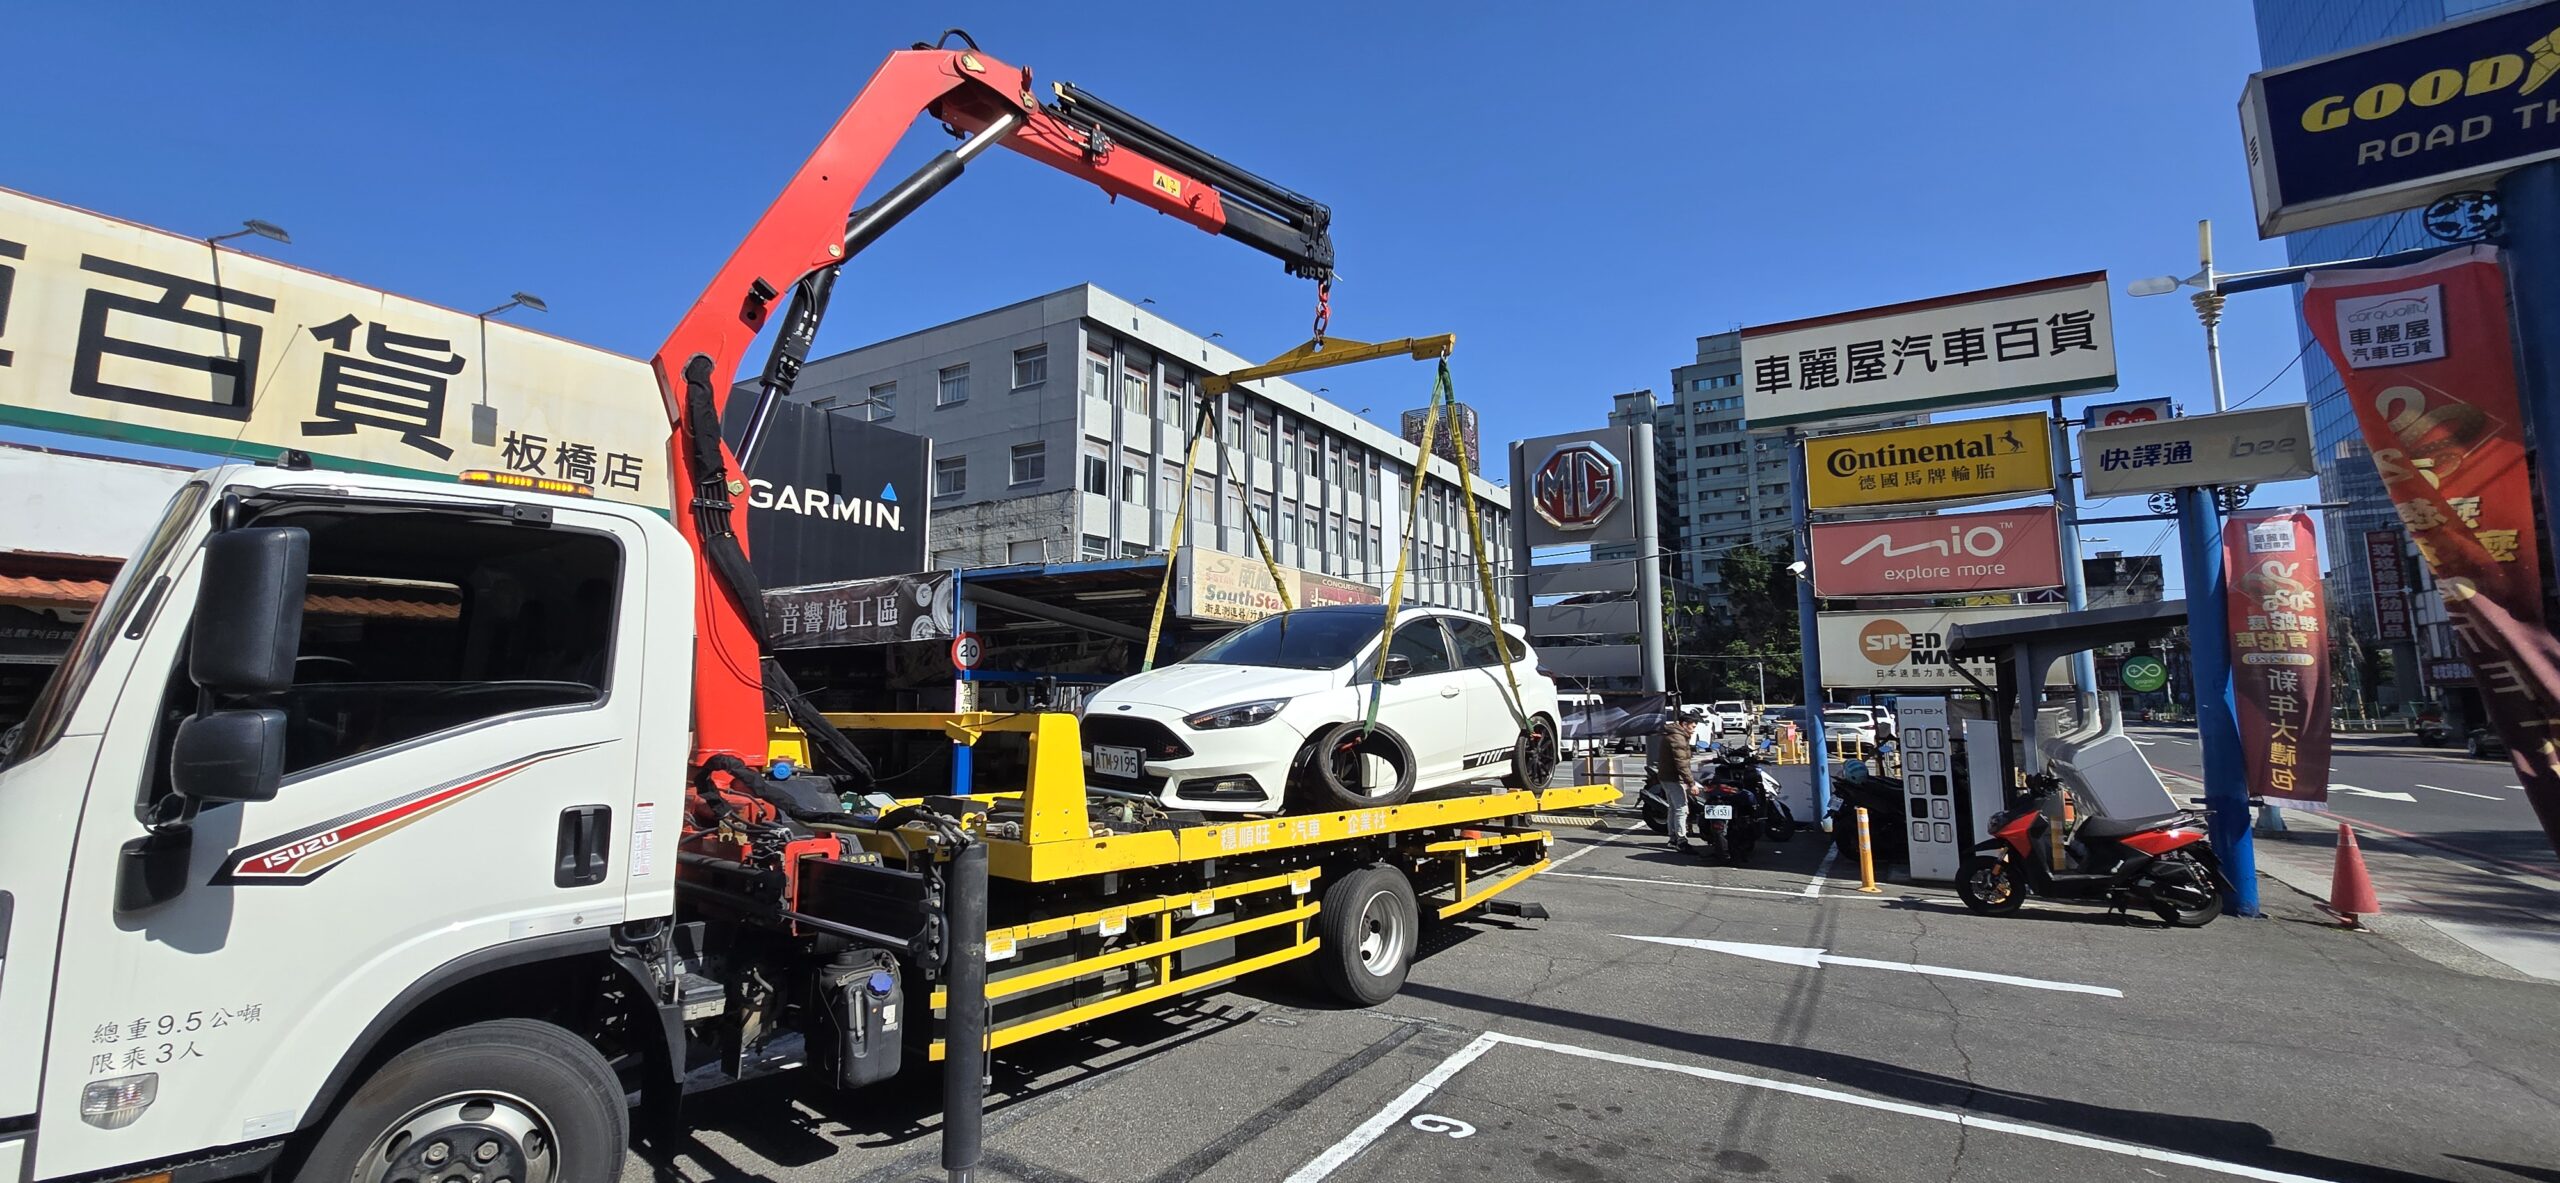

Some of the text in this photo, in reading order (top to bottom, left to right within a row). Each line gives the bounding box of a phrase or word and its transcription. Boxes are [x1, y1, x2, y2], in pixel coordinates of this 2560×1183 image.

[2357, 115, 2493, 166] ROAD
[2349, 319, 2431, 346] 車麗屋
[0, 237, 643, 492] 百貨 板橋店
[1754, 309, 2099, 395] 車麗屋汽車百貨
[2352, 339, 2432, 362] 汽車百貨
[1827, 434, 1996, 477] Continental
[2100, 440, 2192, 472] 快譯通
[1543, 452, 1611, 514] MG
[1858, 463, 1996, 491] 德國馬牌輪胎
[1885, 564, 2005, 582] explore more
[781, 591, 899, 636] 音響施工區
[960, 643, 978, 658] 20
[1866, 632, 1941, 651] SPEED
[1290, 819, 1321, 841] 汽車
[1347, 811, 1387, 835] 企業社
[263, 832, 339, 869] ISUZU
